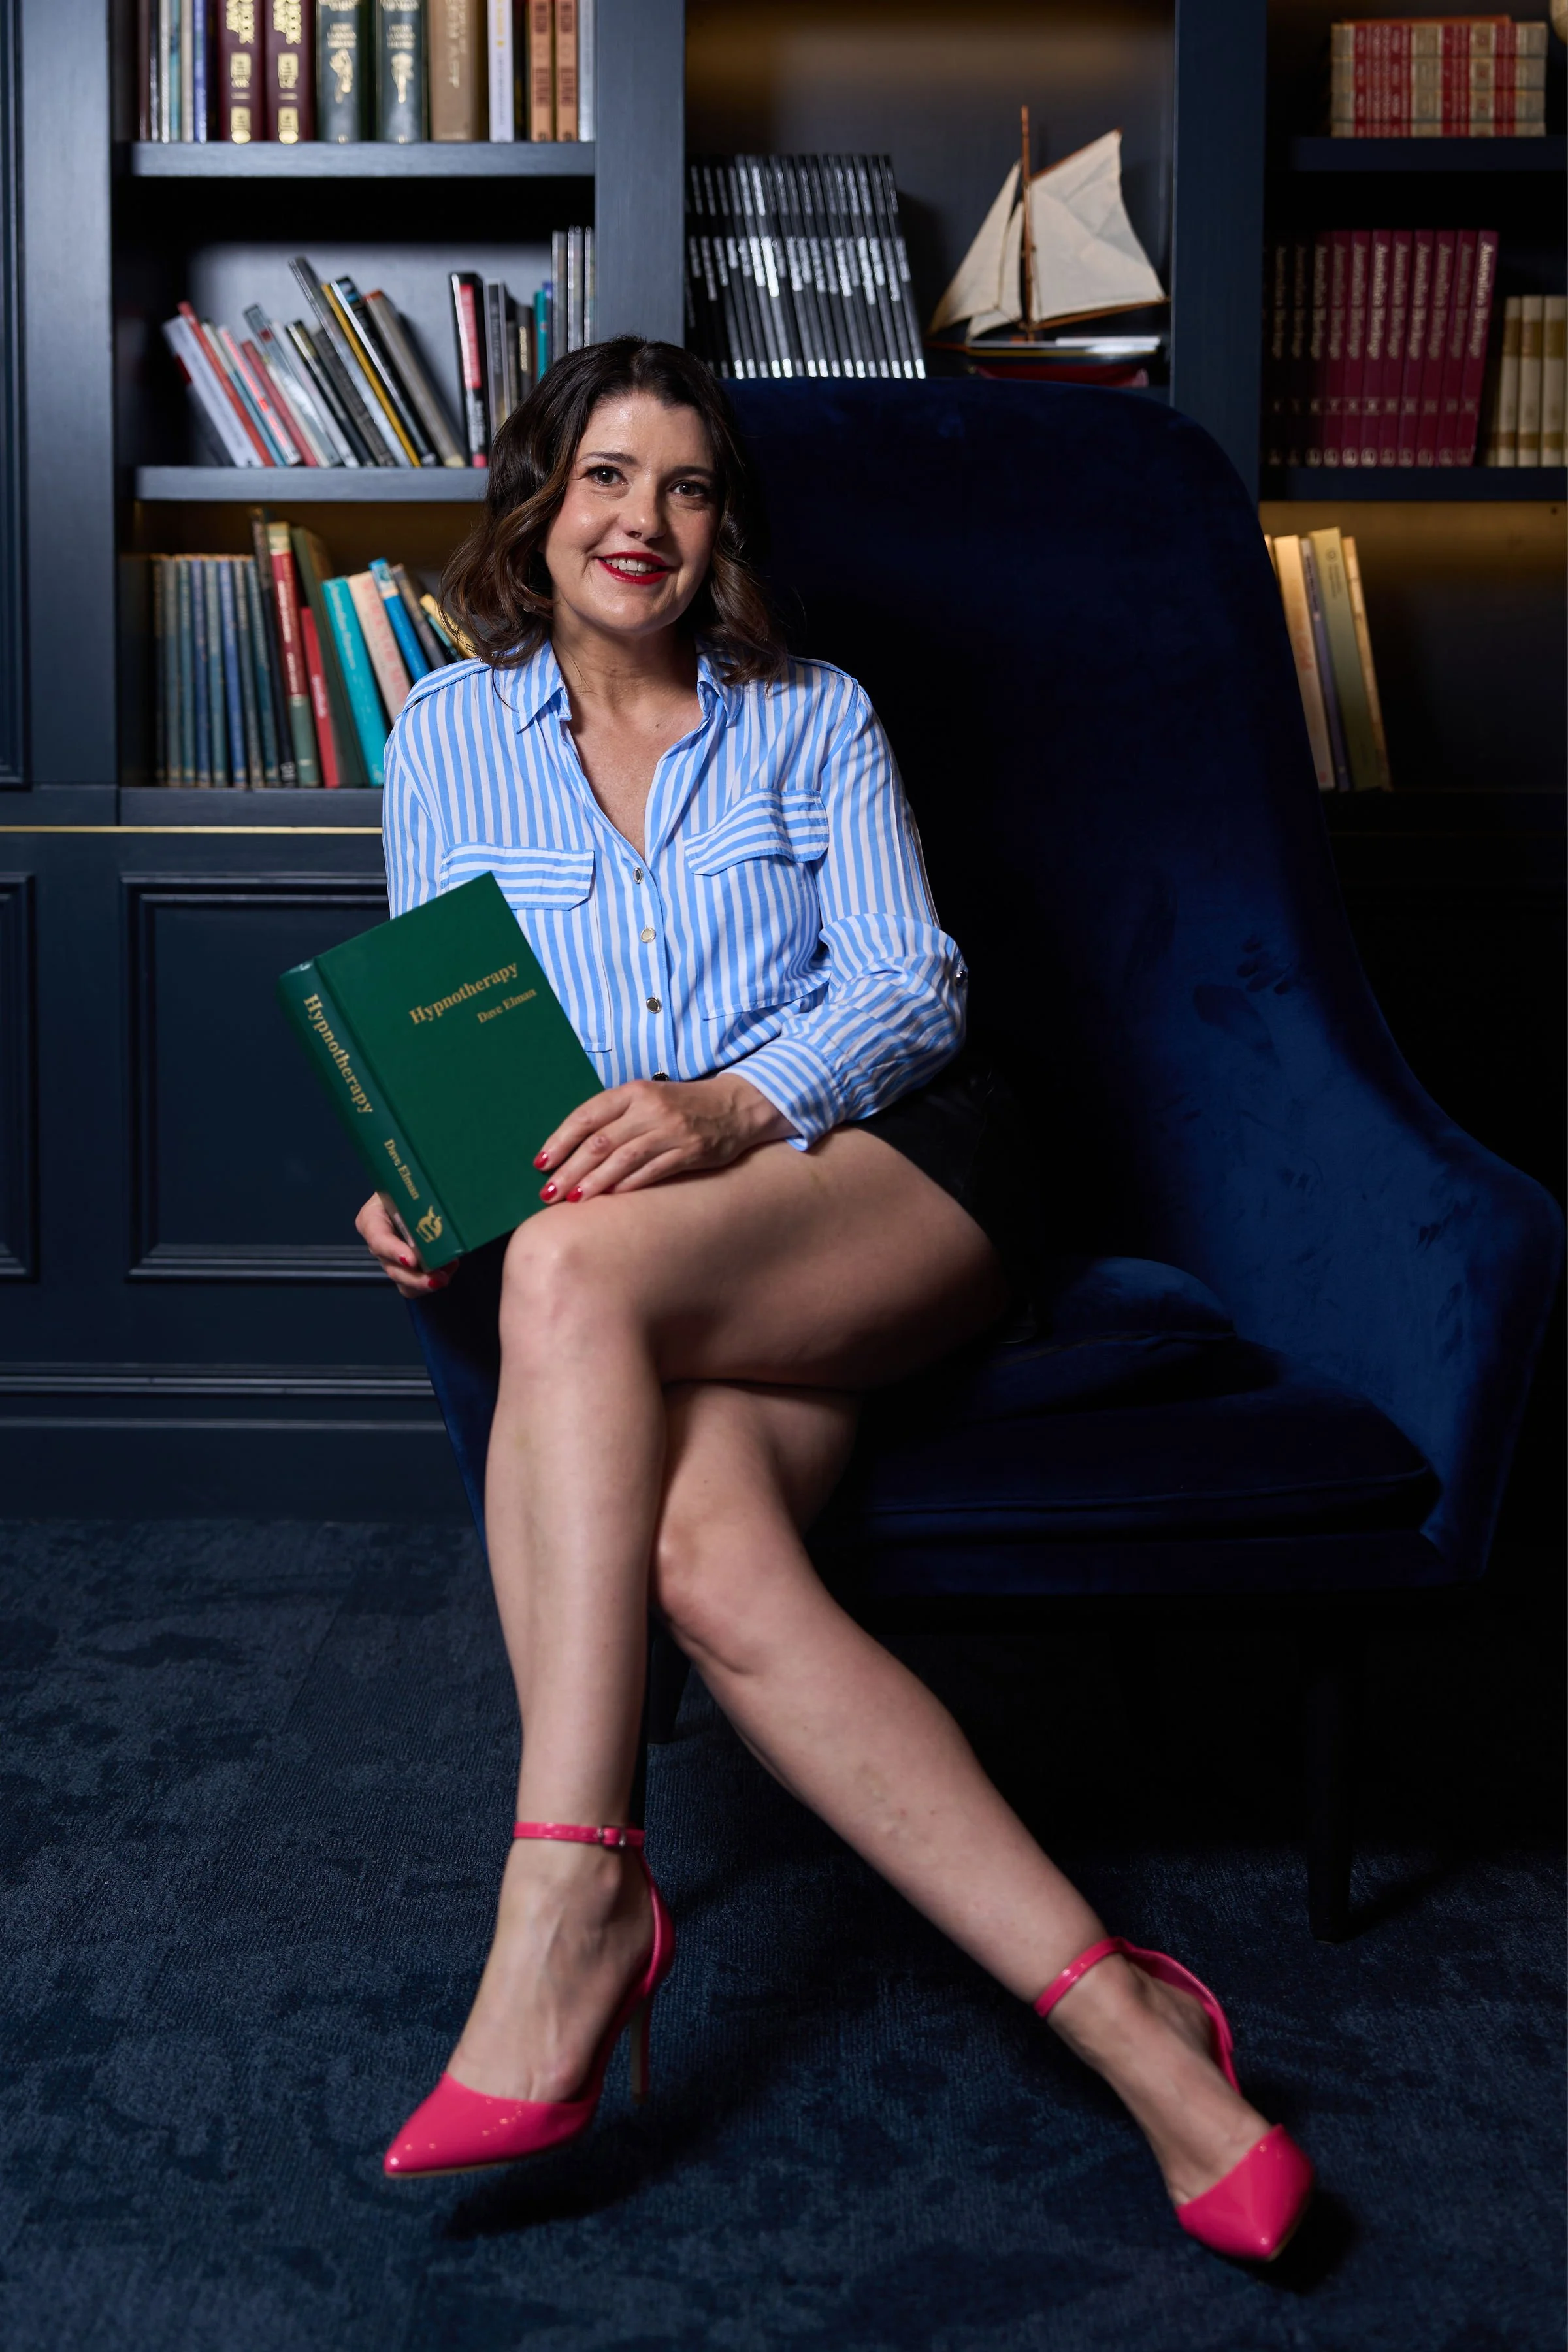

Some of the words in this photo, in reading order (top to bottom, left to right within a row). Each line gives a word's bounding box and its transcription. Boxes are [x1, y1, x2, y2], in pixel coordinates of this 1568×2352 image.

[408, 962, 518, 1025] Hypnotherapy
[476, 1005, 503, 1024] Dave
[502, 988, 538, 1010] Elman
[304, 993, 374, 1114] Hypnotherapy
[384, 1139, 400, 1167] Dave
[399, 1164, 420, 1200] Elman
